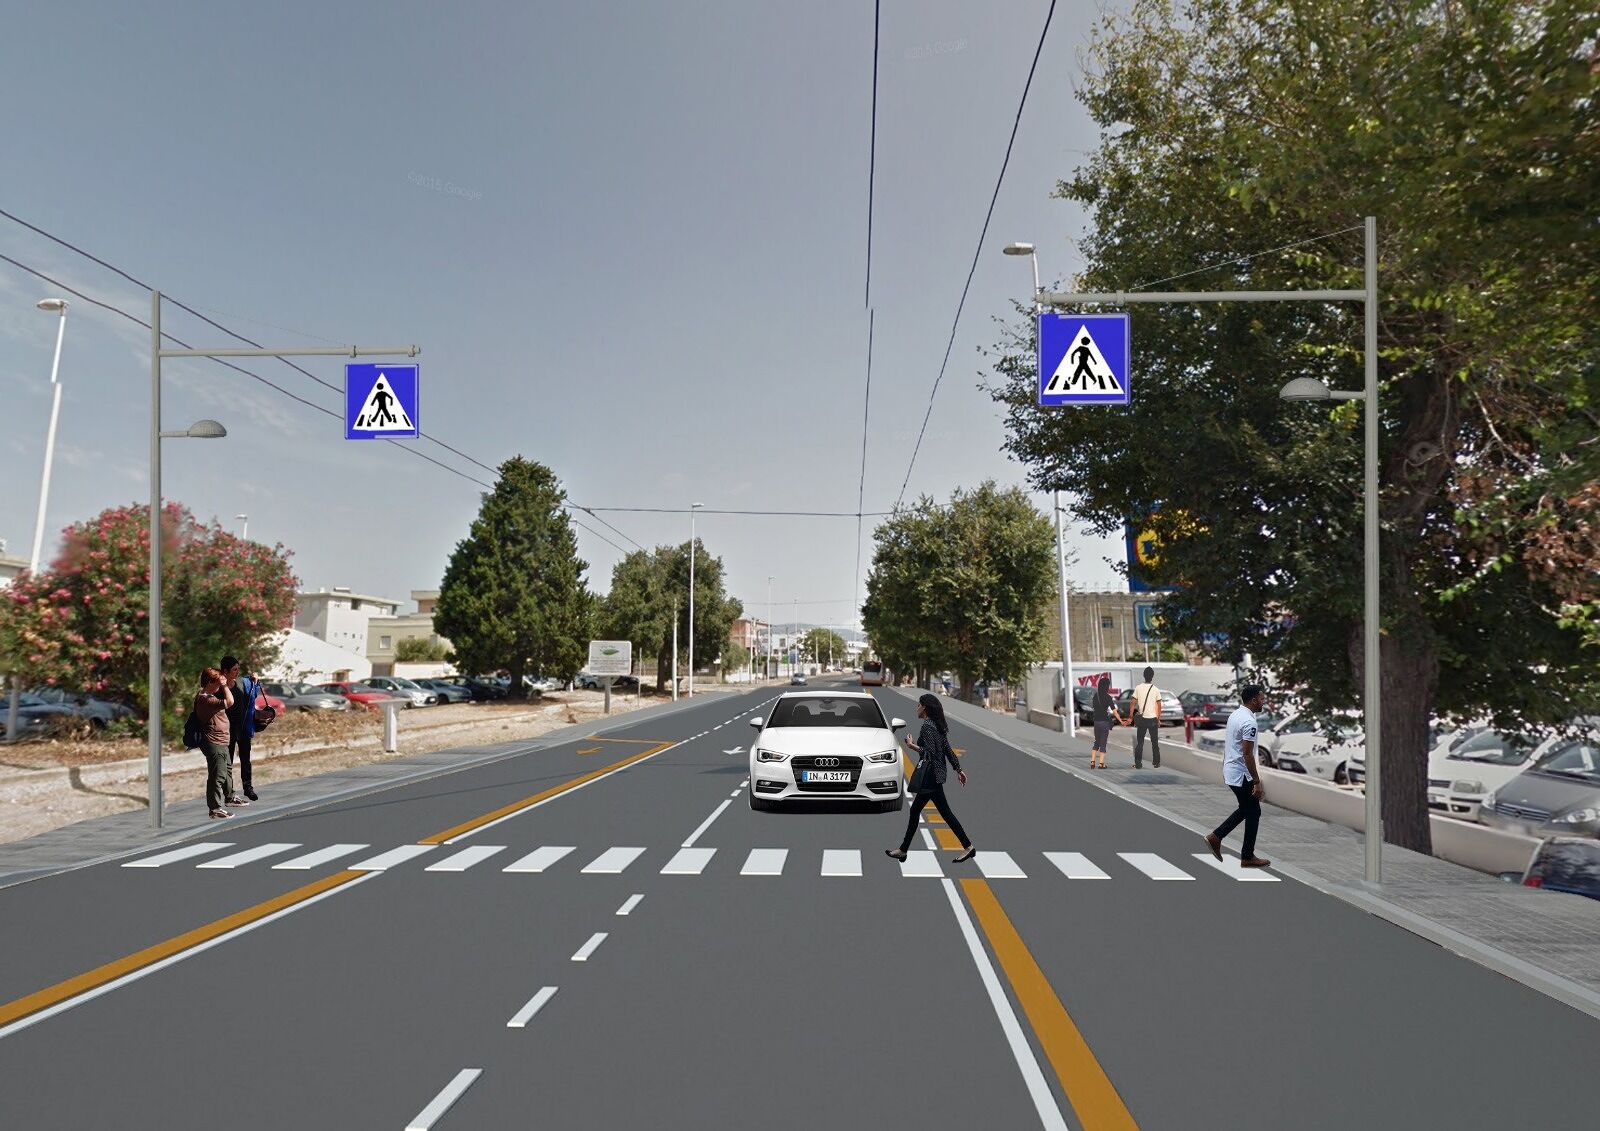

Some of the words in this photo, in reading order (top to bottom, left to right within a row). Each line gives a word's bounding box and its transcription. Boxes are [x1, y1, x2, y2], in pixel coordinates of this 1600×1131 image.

[1250, 727, 1257, 738] 3
[809, 772, 819, 781] IN
[823, 772, 829, 781] A
[830, 772, 850, 781] 3177
